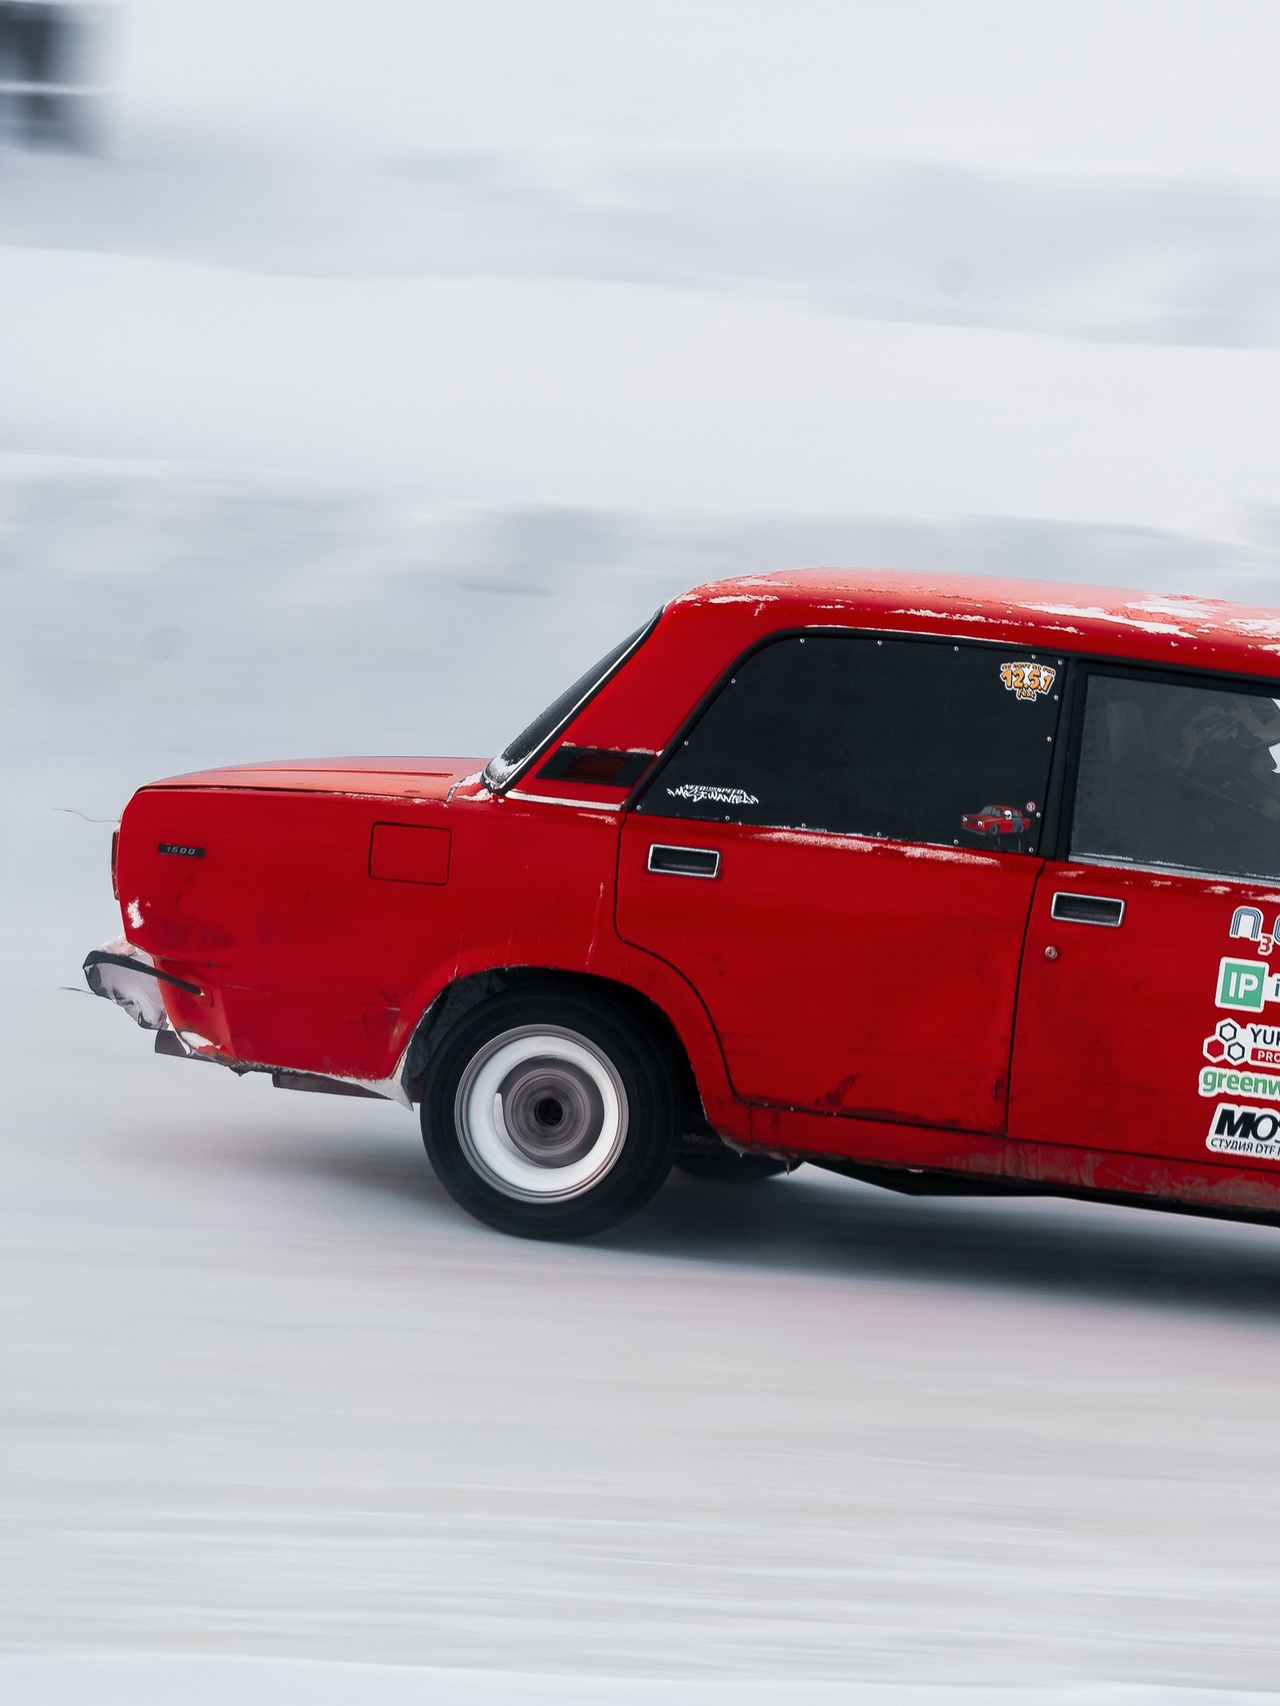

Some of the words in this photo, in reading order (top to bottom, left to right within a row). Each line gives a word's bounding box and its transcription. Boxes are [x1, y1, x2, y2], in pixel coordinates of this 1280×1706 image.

[1228, 971, 1258, 999] IP
[1210, 1137, 1253, 1152] СТУДИЯ
[1255, 1143, 1276, 1155] DTF
